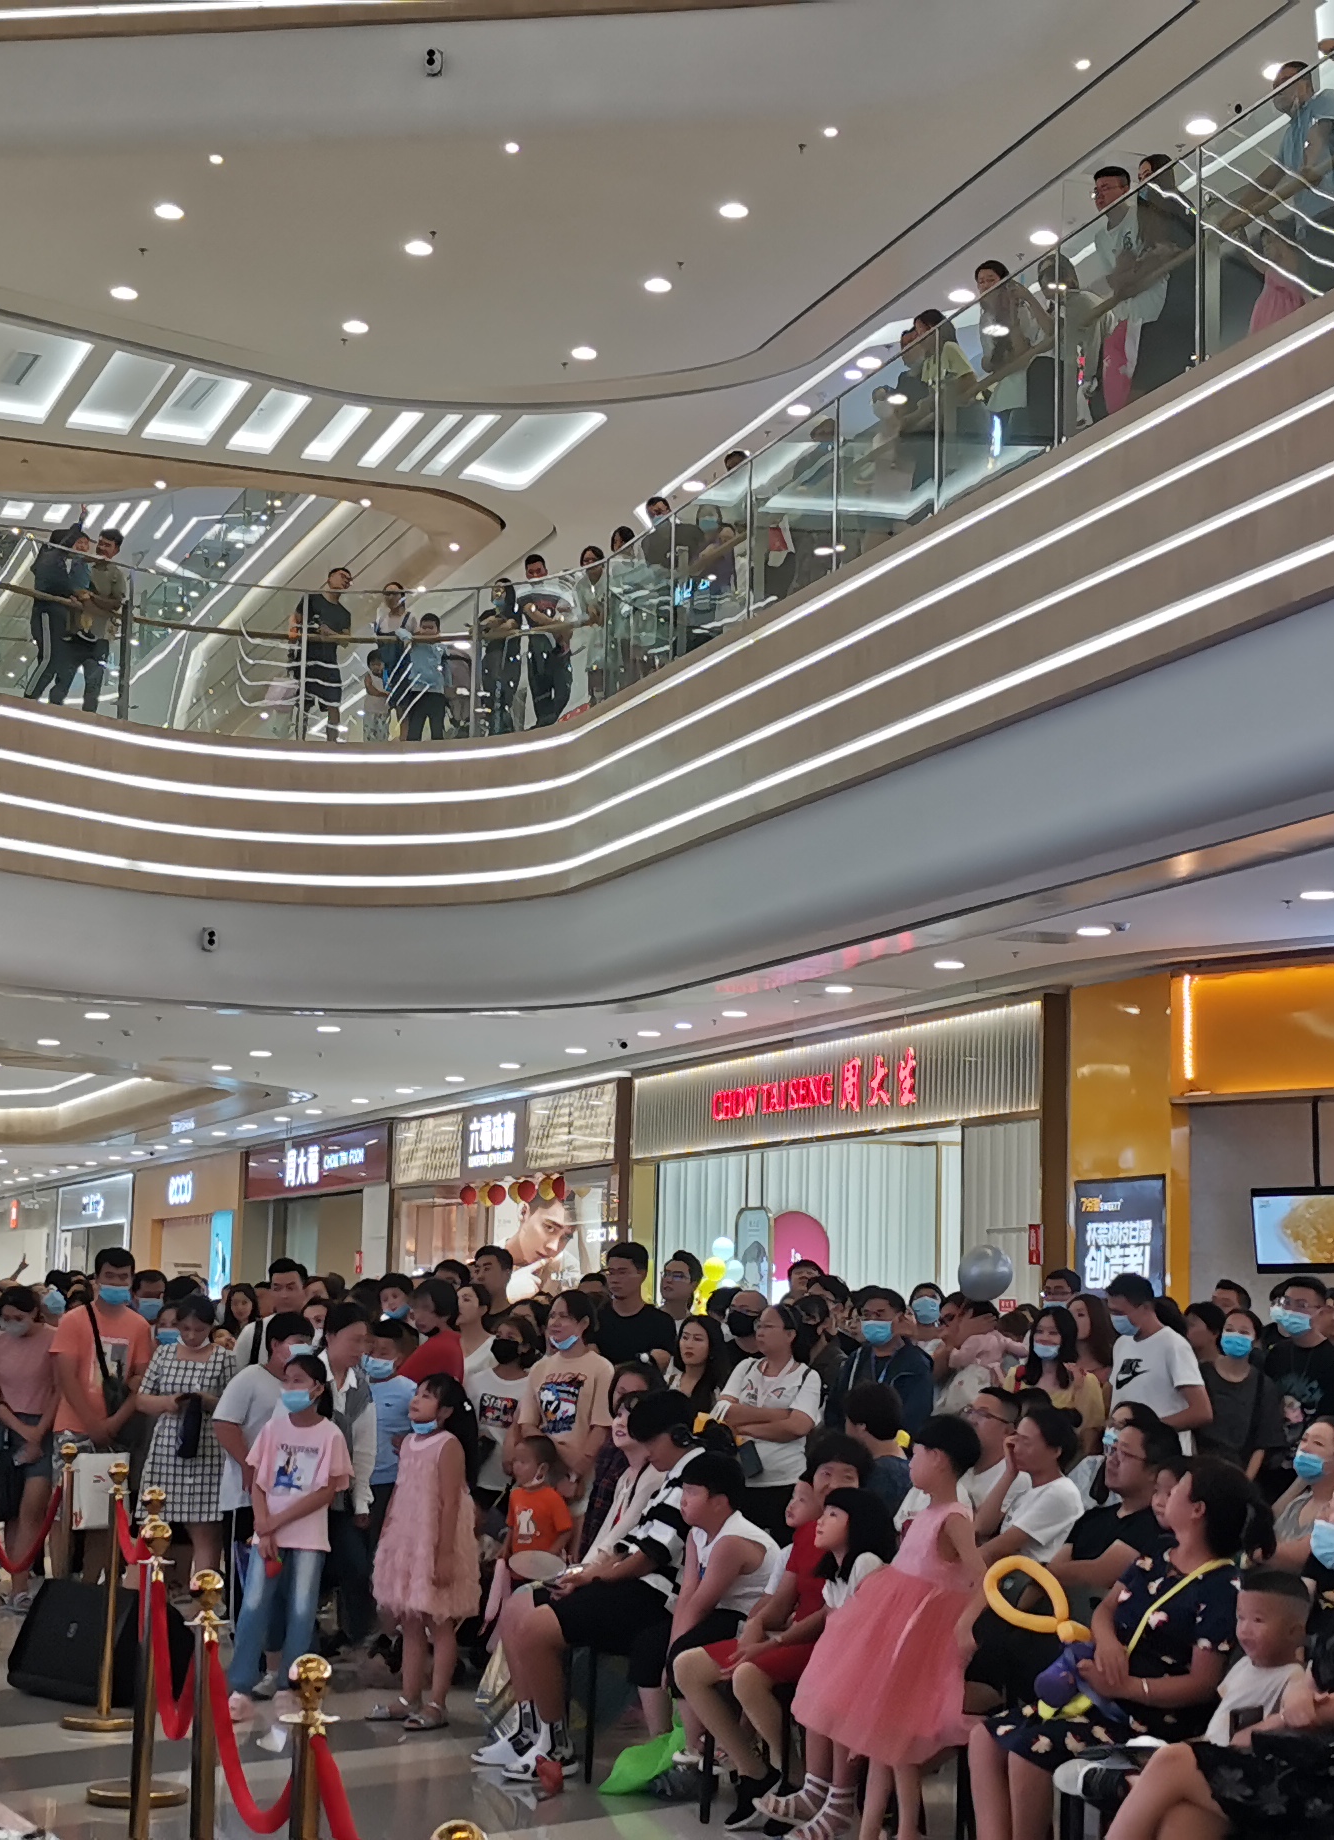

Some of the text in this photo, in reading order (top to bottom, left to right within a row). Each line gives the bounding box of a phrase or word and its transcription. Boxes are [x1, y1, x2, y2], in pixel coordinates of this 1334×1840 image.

[712, 1073, 834, 1121] CHOW TAI SENG
[839, 1047, 917, 1112] 周大生
[284, 1144, 320, 1188] 周大福
